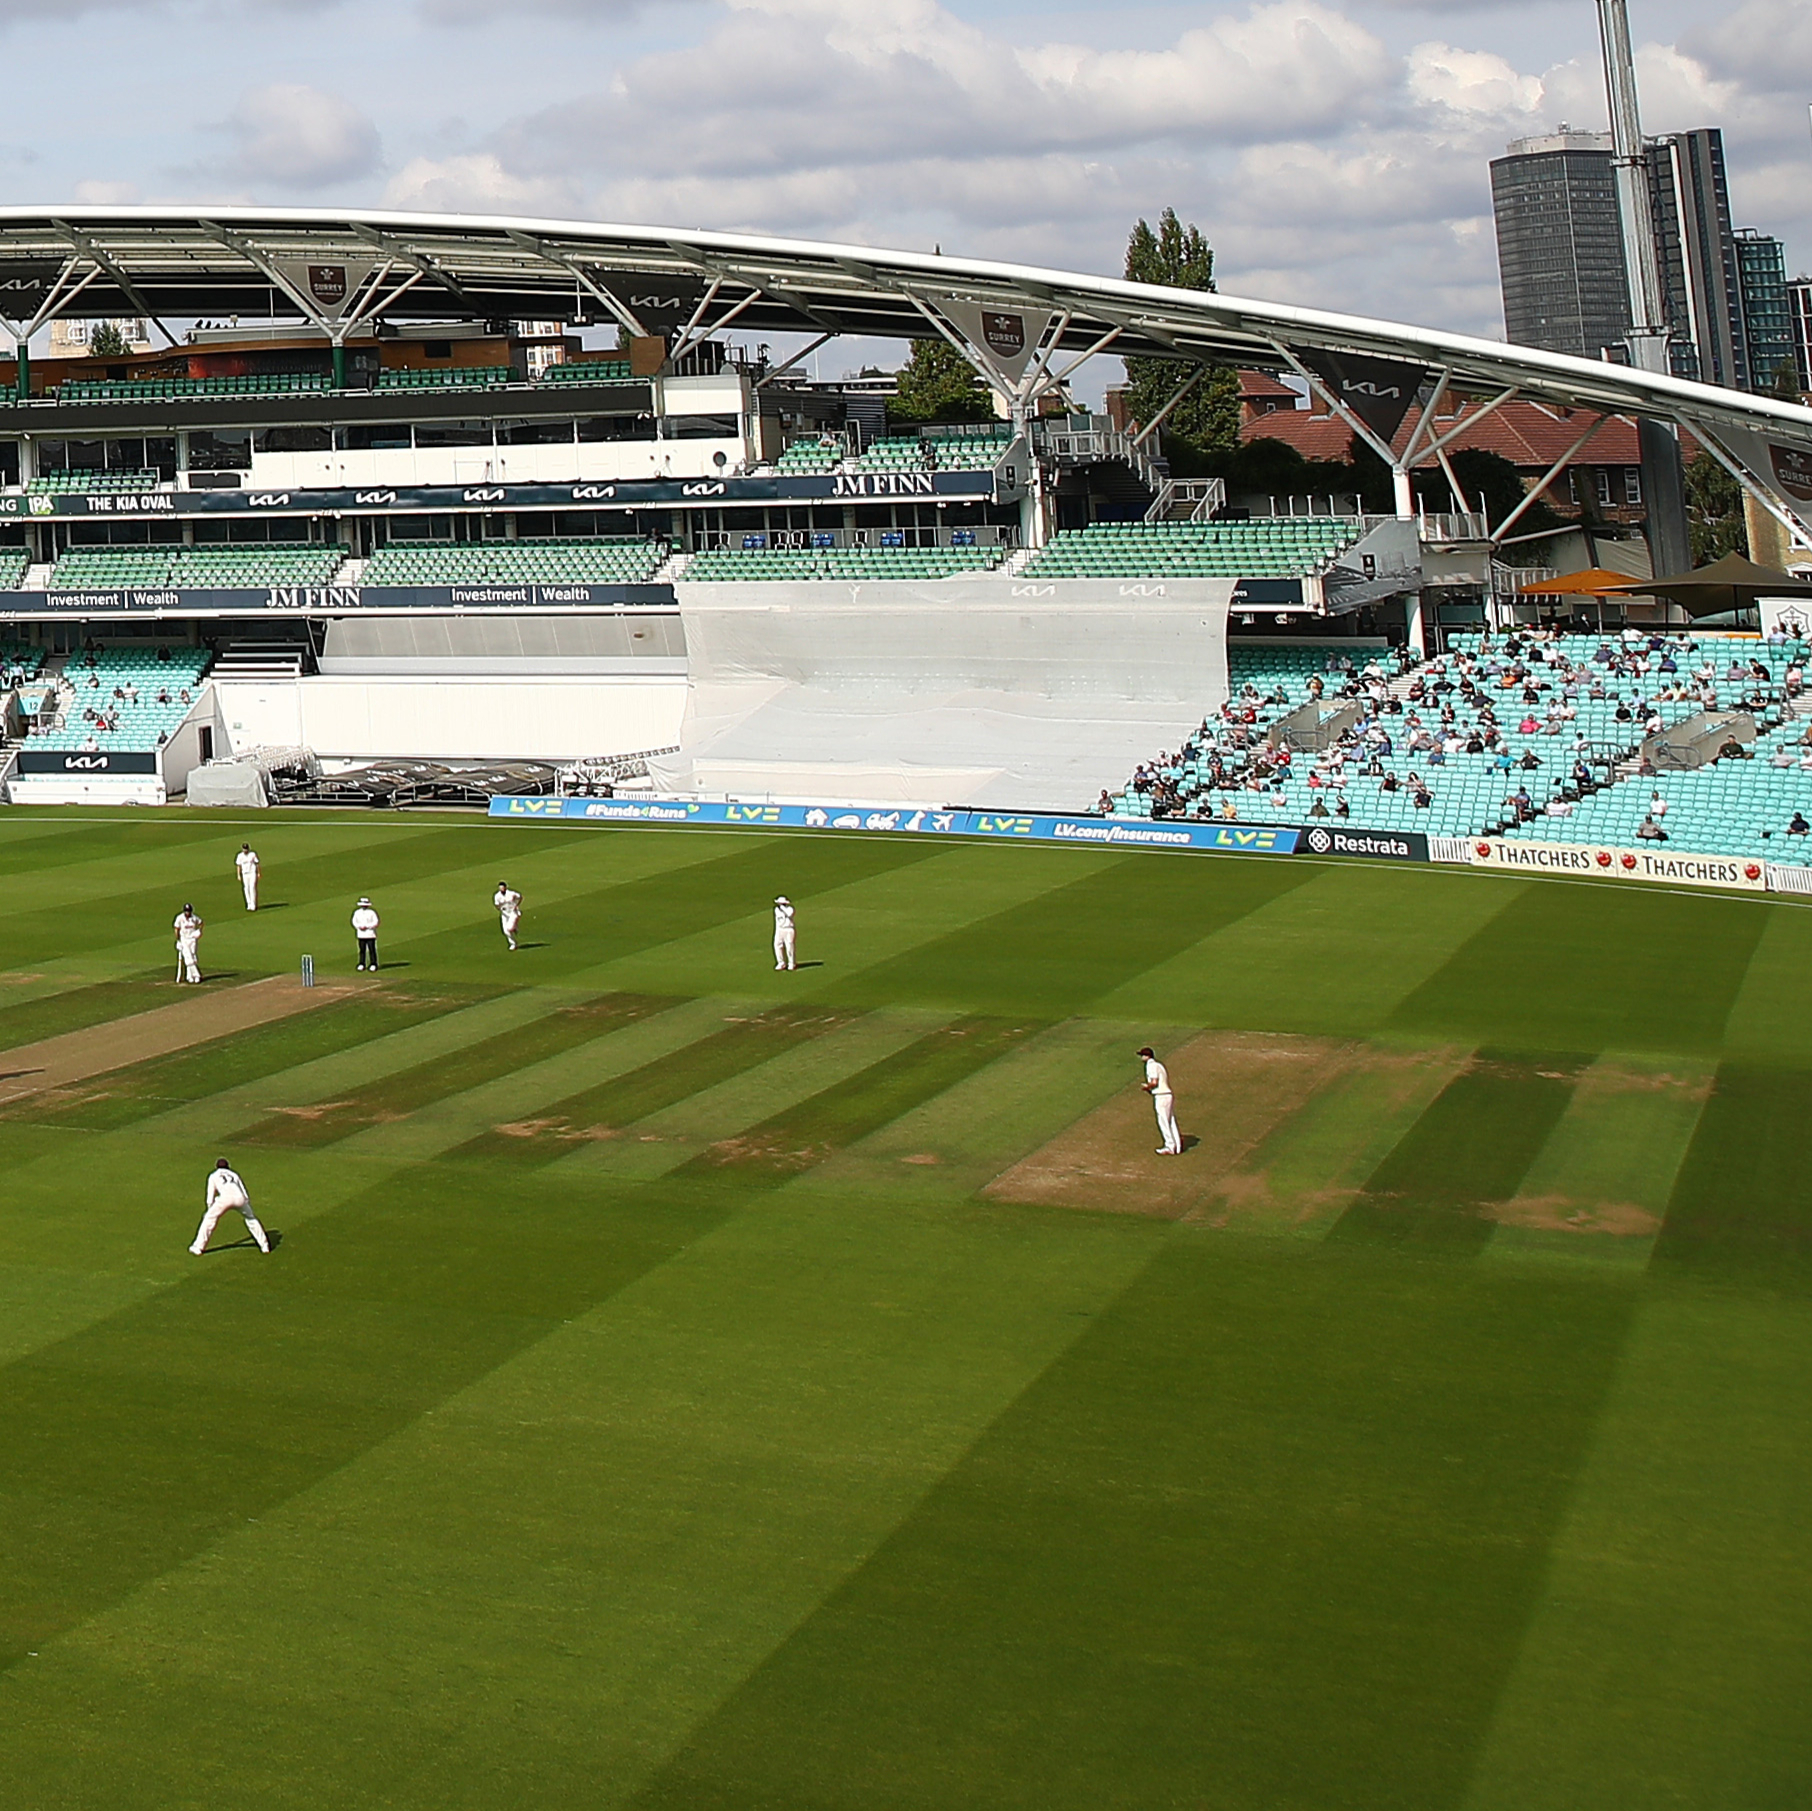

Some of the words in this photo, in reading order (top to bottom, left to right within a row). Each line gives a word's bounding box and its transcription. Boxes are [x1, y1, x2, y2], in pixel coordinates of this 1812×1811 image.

[988, 331, 1020, 344] SURREY
[833, 475, 866, 495] JM
[872, 474, 933, 494] FINN
[28, 496, 53, 513] IPA
[86, 497, 112, 511] THE
[116, 496, 139, 510] KIA
[140, 495, 174, 510] OVAL
[46, 593, 119, 607] Investment
[134, 592, 178, 605] Wealth
[267, 589, 298, 607] JM
[305, 588, 360, 606] FINN
[451, 588, 526, 602] Investment
[542, 586, 590, 601] Wealth
[585, 803, 687, 821] #Funds4Runs
[1334, 834, 1409, 856] Restrata
[1495, 844, 1590, 869] THATCHERS
[1642, 856, 1737, 881] THATCHERS
[220, 1174, 235, 1185] 32
